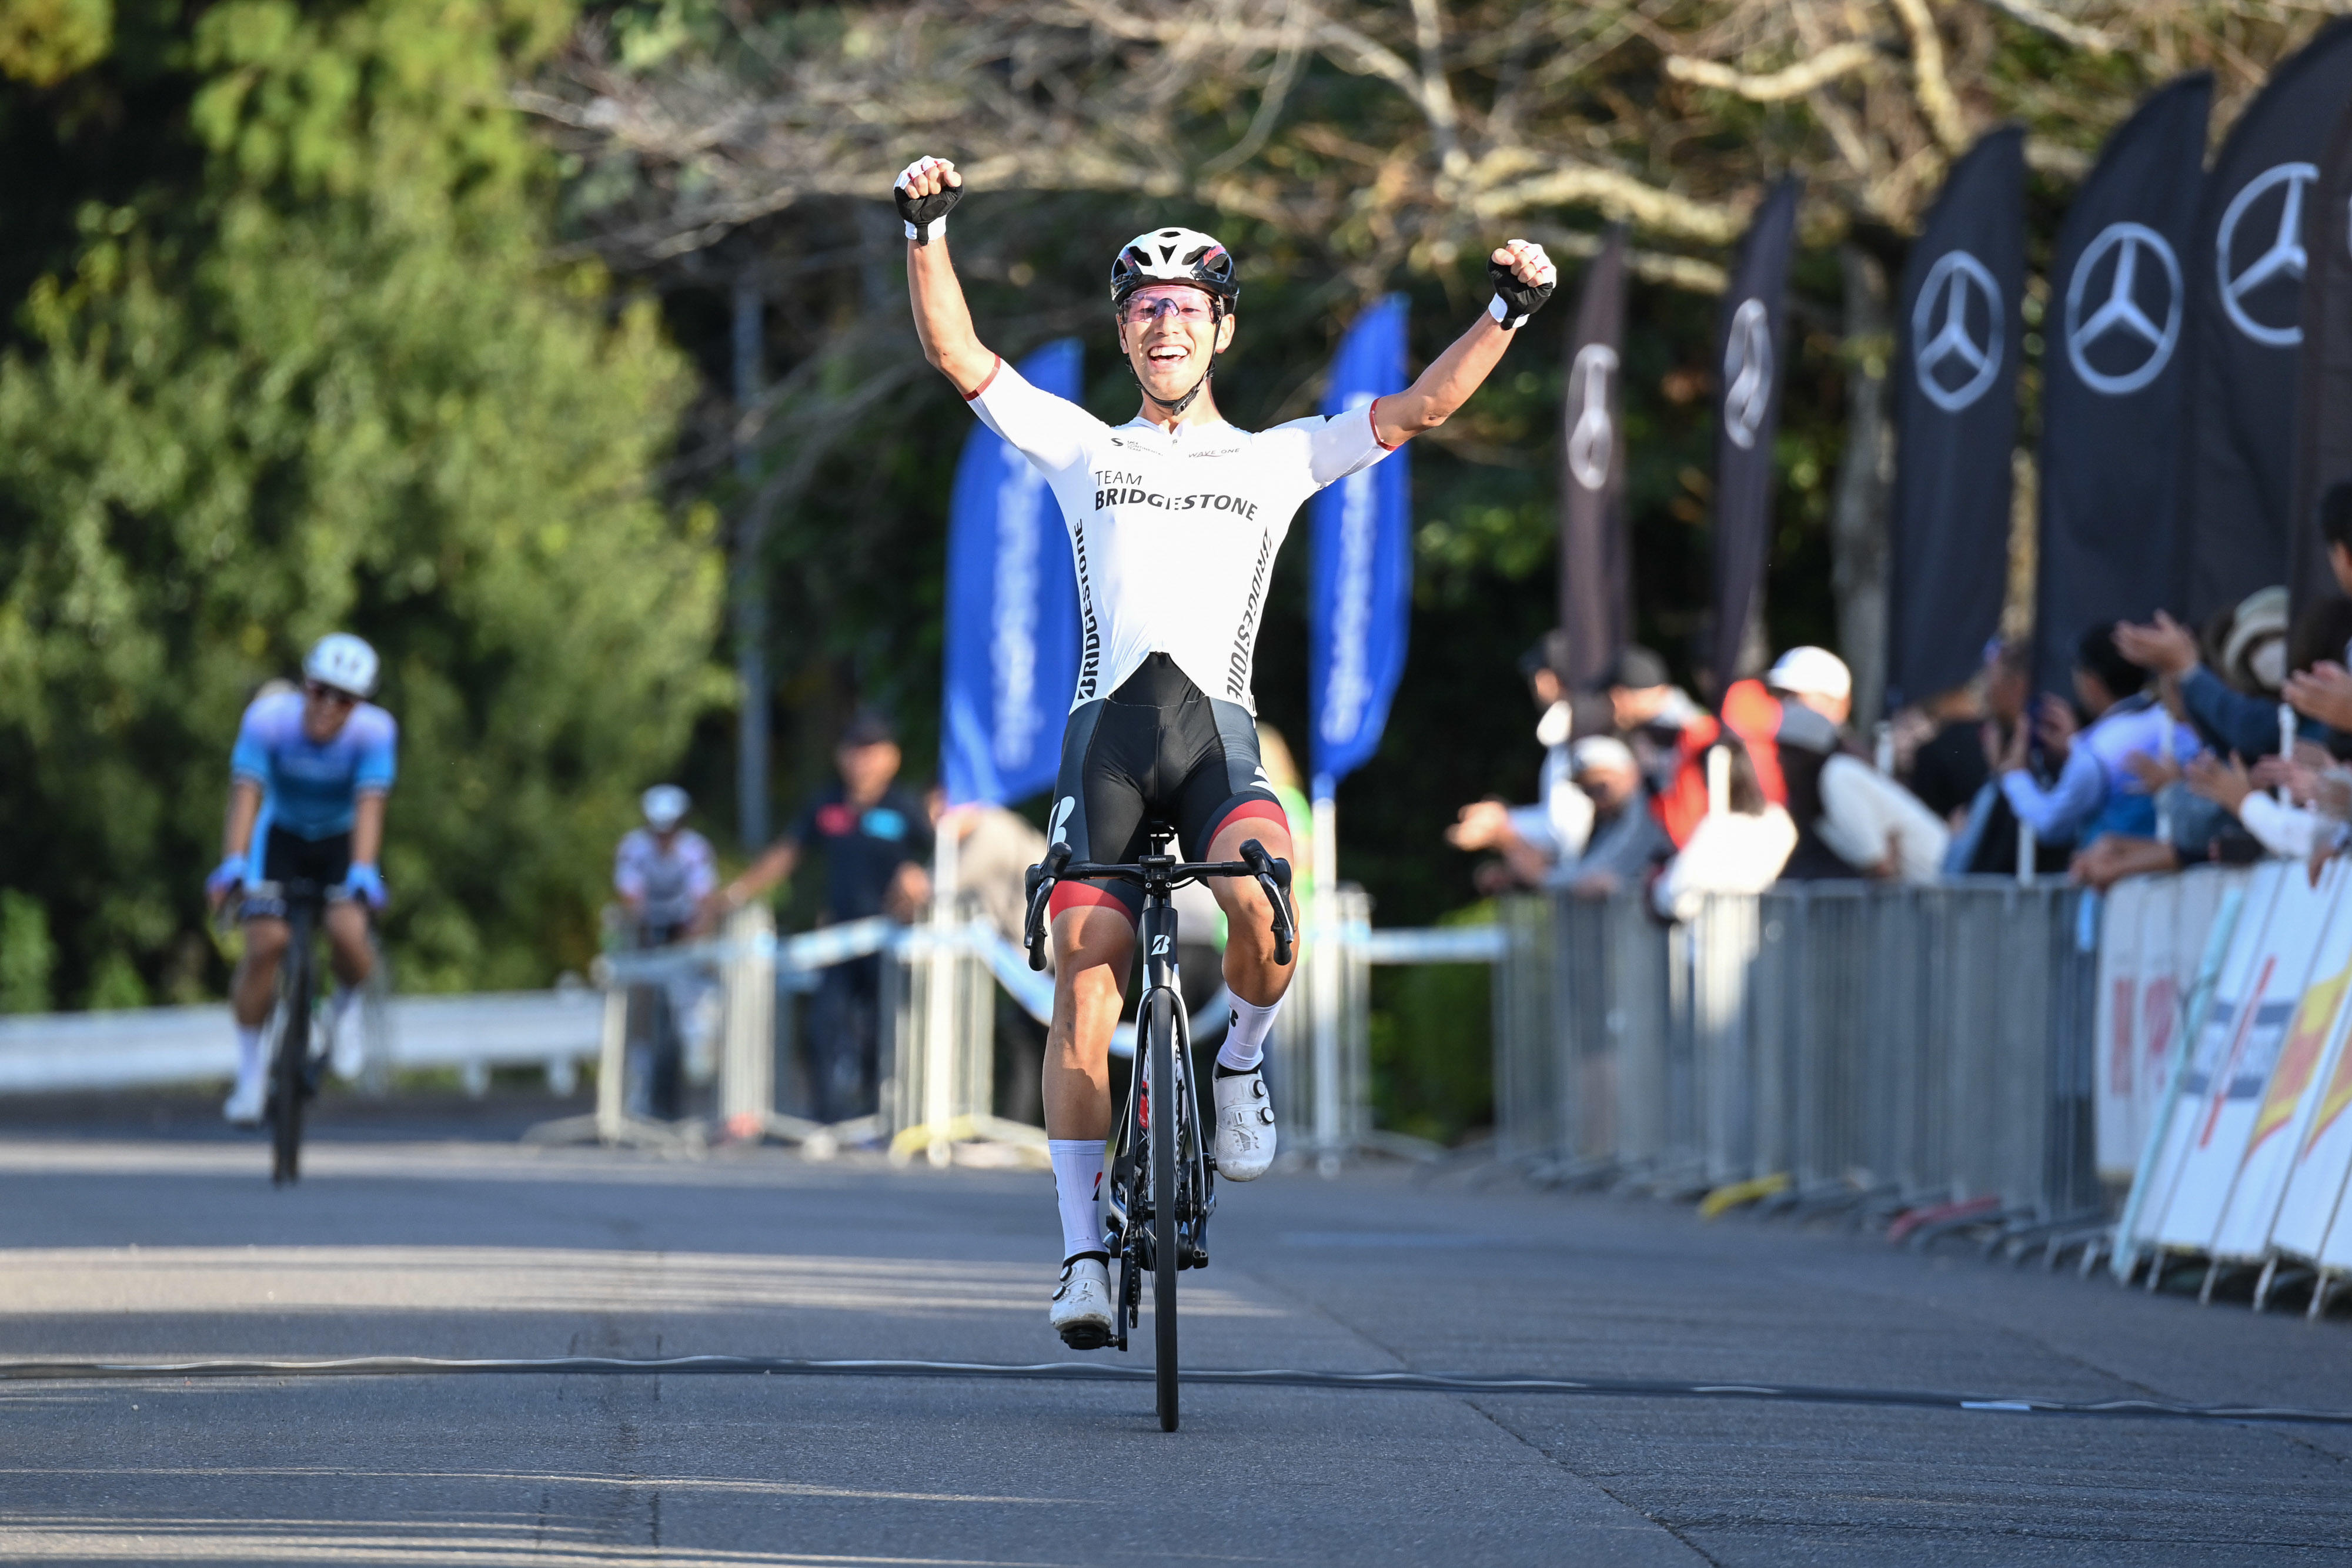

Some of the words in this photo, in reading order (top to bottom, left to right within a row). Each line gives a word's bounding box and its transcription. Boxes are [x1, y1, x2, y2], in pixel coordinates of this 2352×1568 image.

[1095, 470, 1142, 486] TEAM
[1095, 488, 1258, 521] BRIDGESTONE
[1074, 519, 1100, 699] BRIDGESTONE
